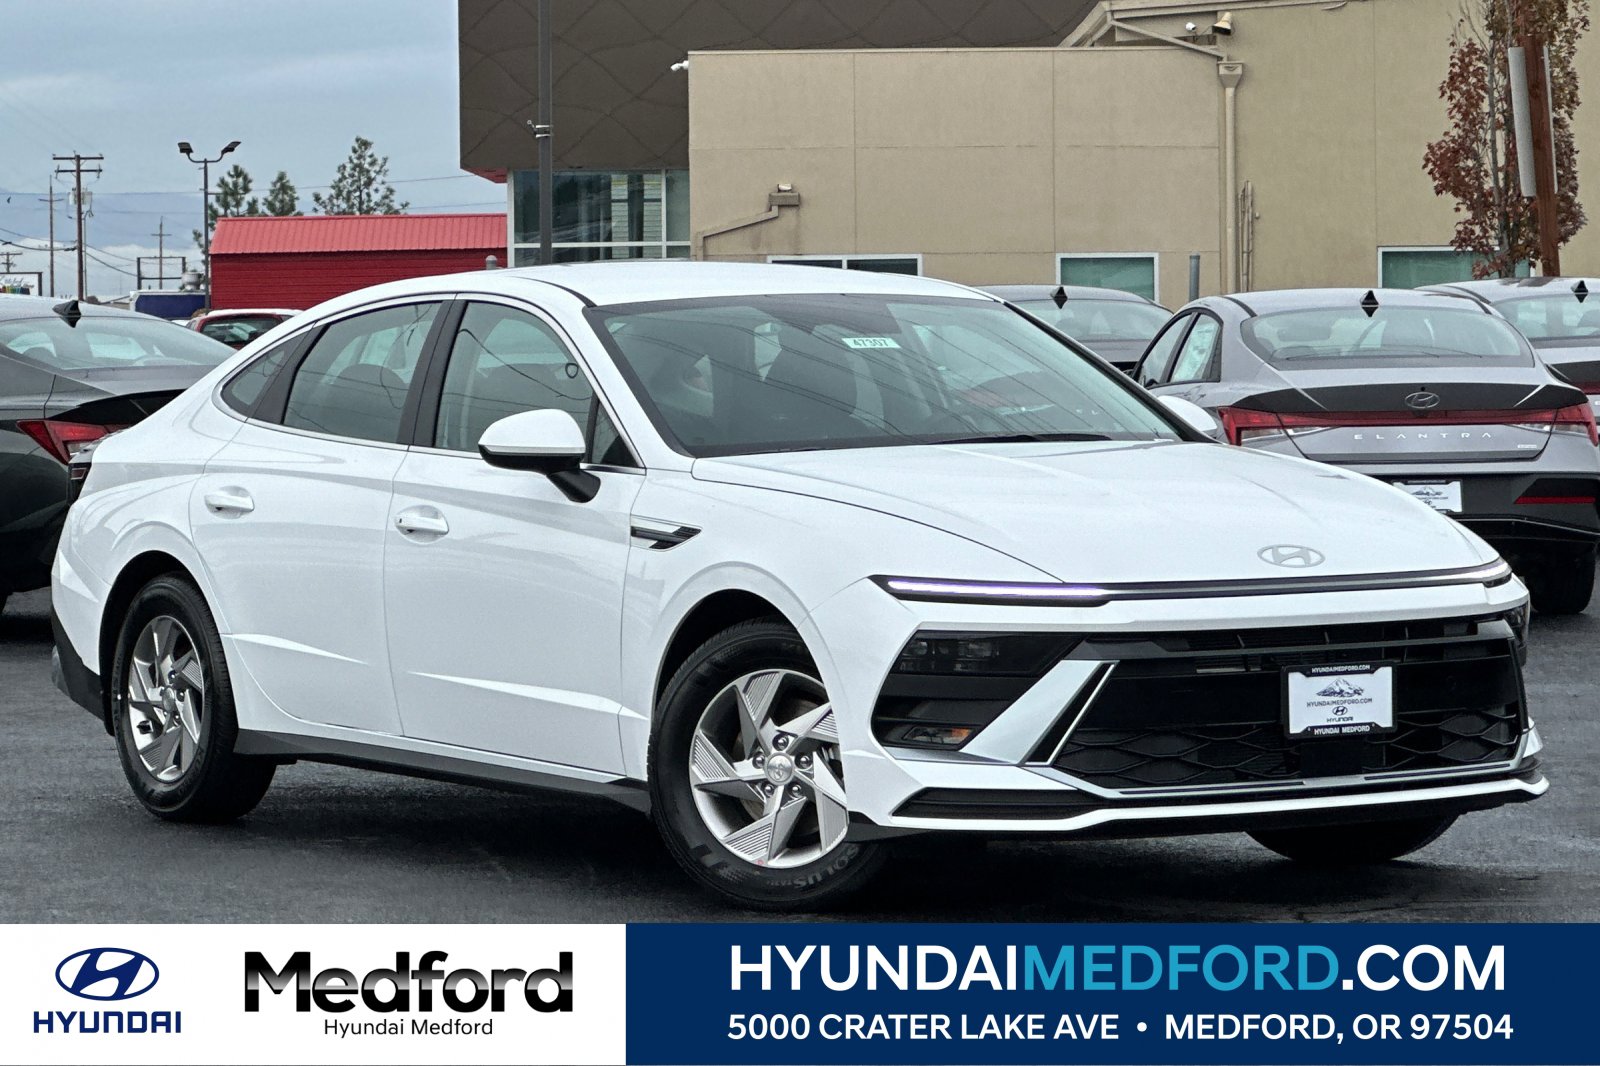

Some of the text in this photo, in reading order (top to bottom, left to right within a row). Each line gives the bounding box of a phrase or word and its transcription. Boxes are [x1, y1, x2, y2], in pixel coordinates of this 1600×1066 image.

[853, 339, 889, 347] 47307
[1354, 432, 1492, 440] ELANTRA
[1311, 664, 1371, 674] HYUNDAIMEDFORD.COM
[1306, 697, 1373, 708] HYUNDAIMEDFORD.COM
[1314, 725, 1371, 735] HYUNDAI MEDFORD
